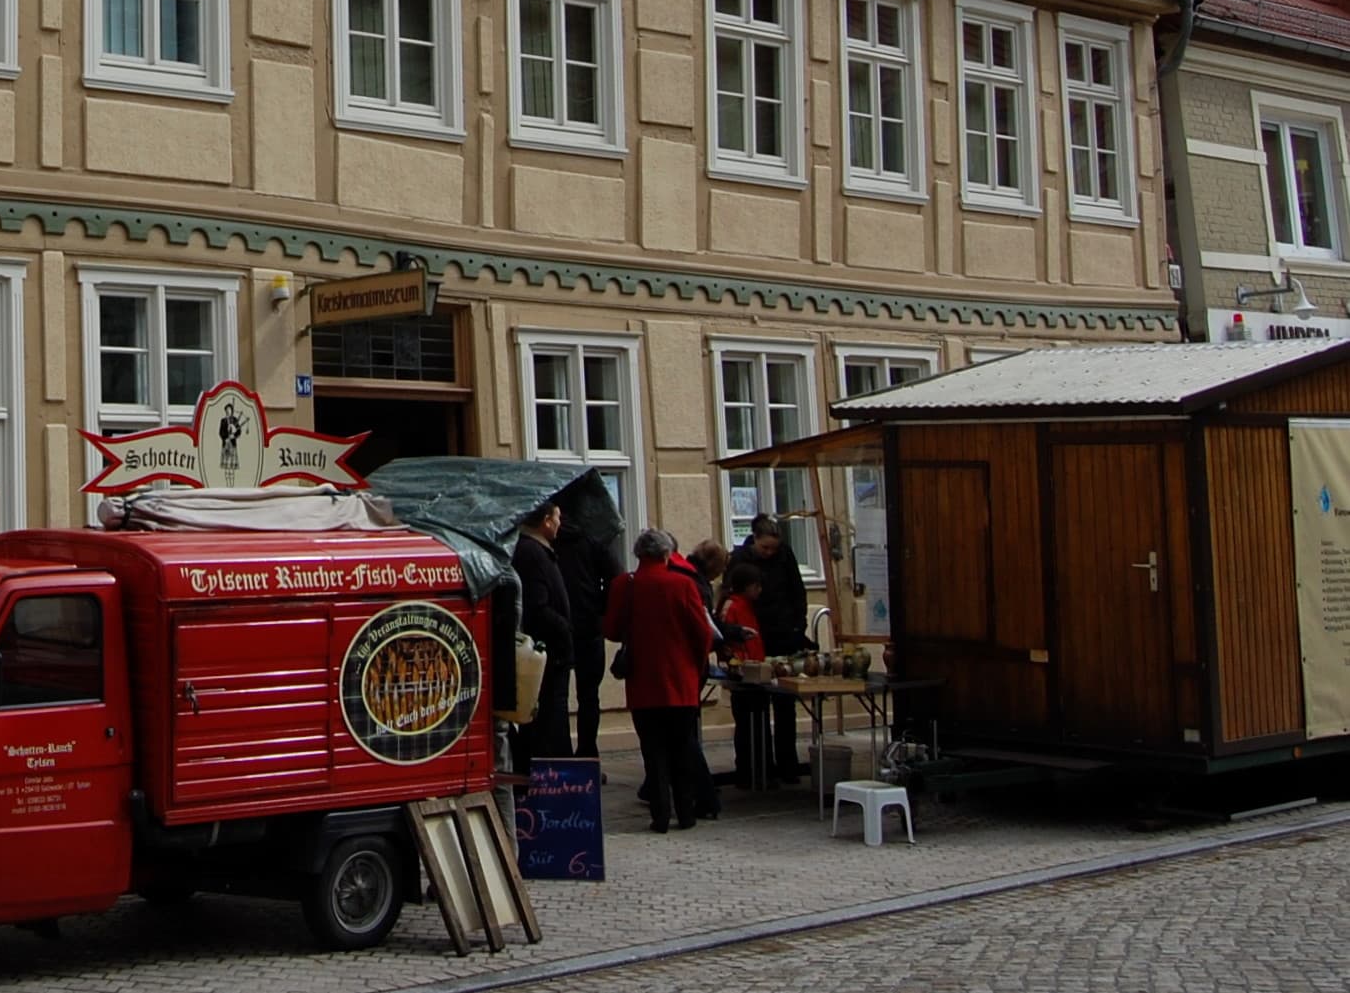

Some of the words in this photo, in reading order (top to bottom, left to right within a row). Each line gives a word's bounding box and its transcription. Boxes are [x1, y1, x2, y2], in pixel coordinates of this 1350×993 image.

[125, 448, 196, 471] Schotten
[279, 448, 327, 470] Rauch
[180, 567, 269, 596] "Tylsener
[369, 614, 438, 643] Veranstaltungen
